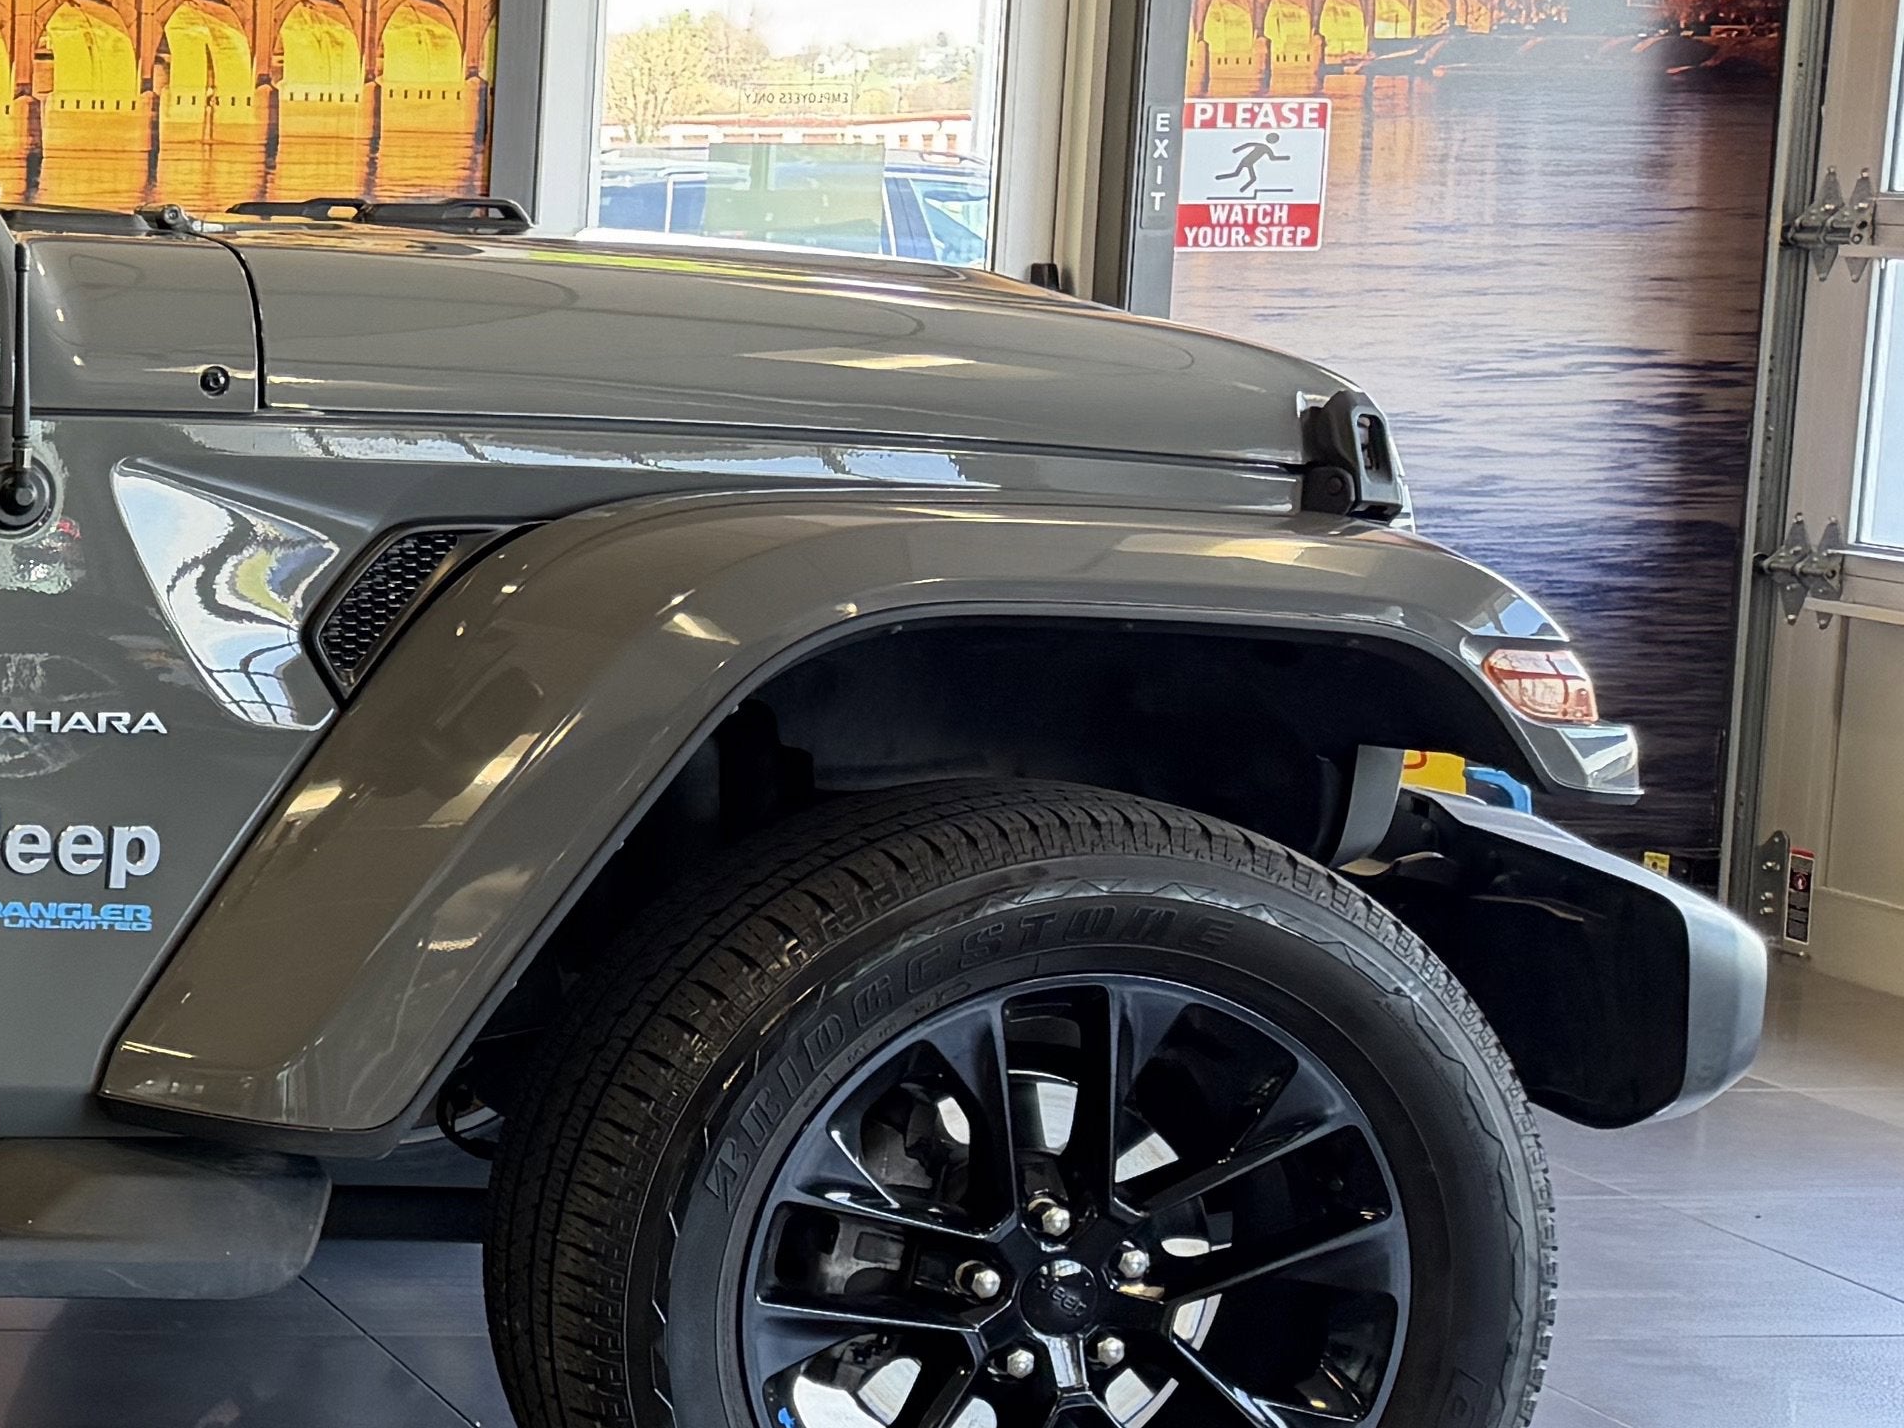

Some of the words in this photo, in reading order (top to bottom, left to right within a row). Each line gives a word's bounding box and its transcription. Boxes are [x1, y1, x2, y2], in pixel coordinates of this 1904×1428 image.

[1194, 103, 1320, 128] PLEASE
[1151, 113, 1171, 211] EXIT
[1209, 205, 1288, 225] WATCH
[1184, 226, 1248, 247] YOUR
[1254, 226, 1311, 247] STEP
[3, 918, 152, 932] UNLIMITED
